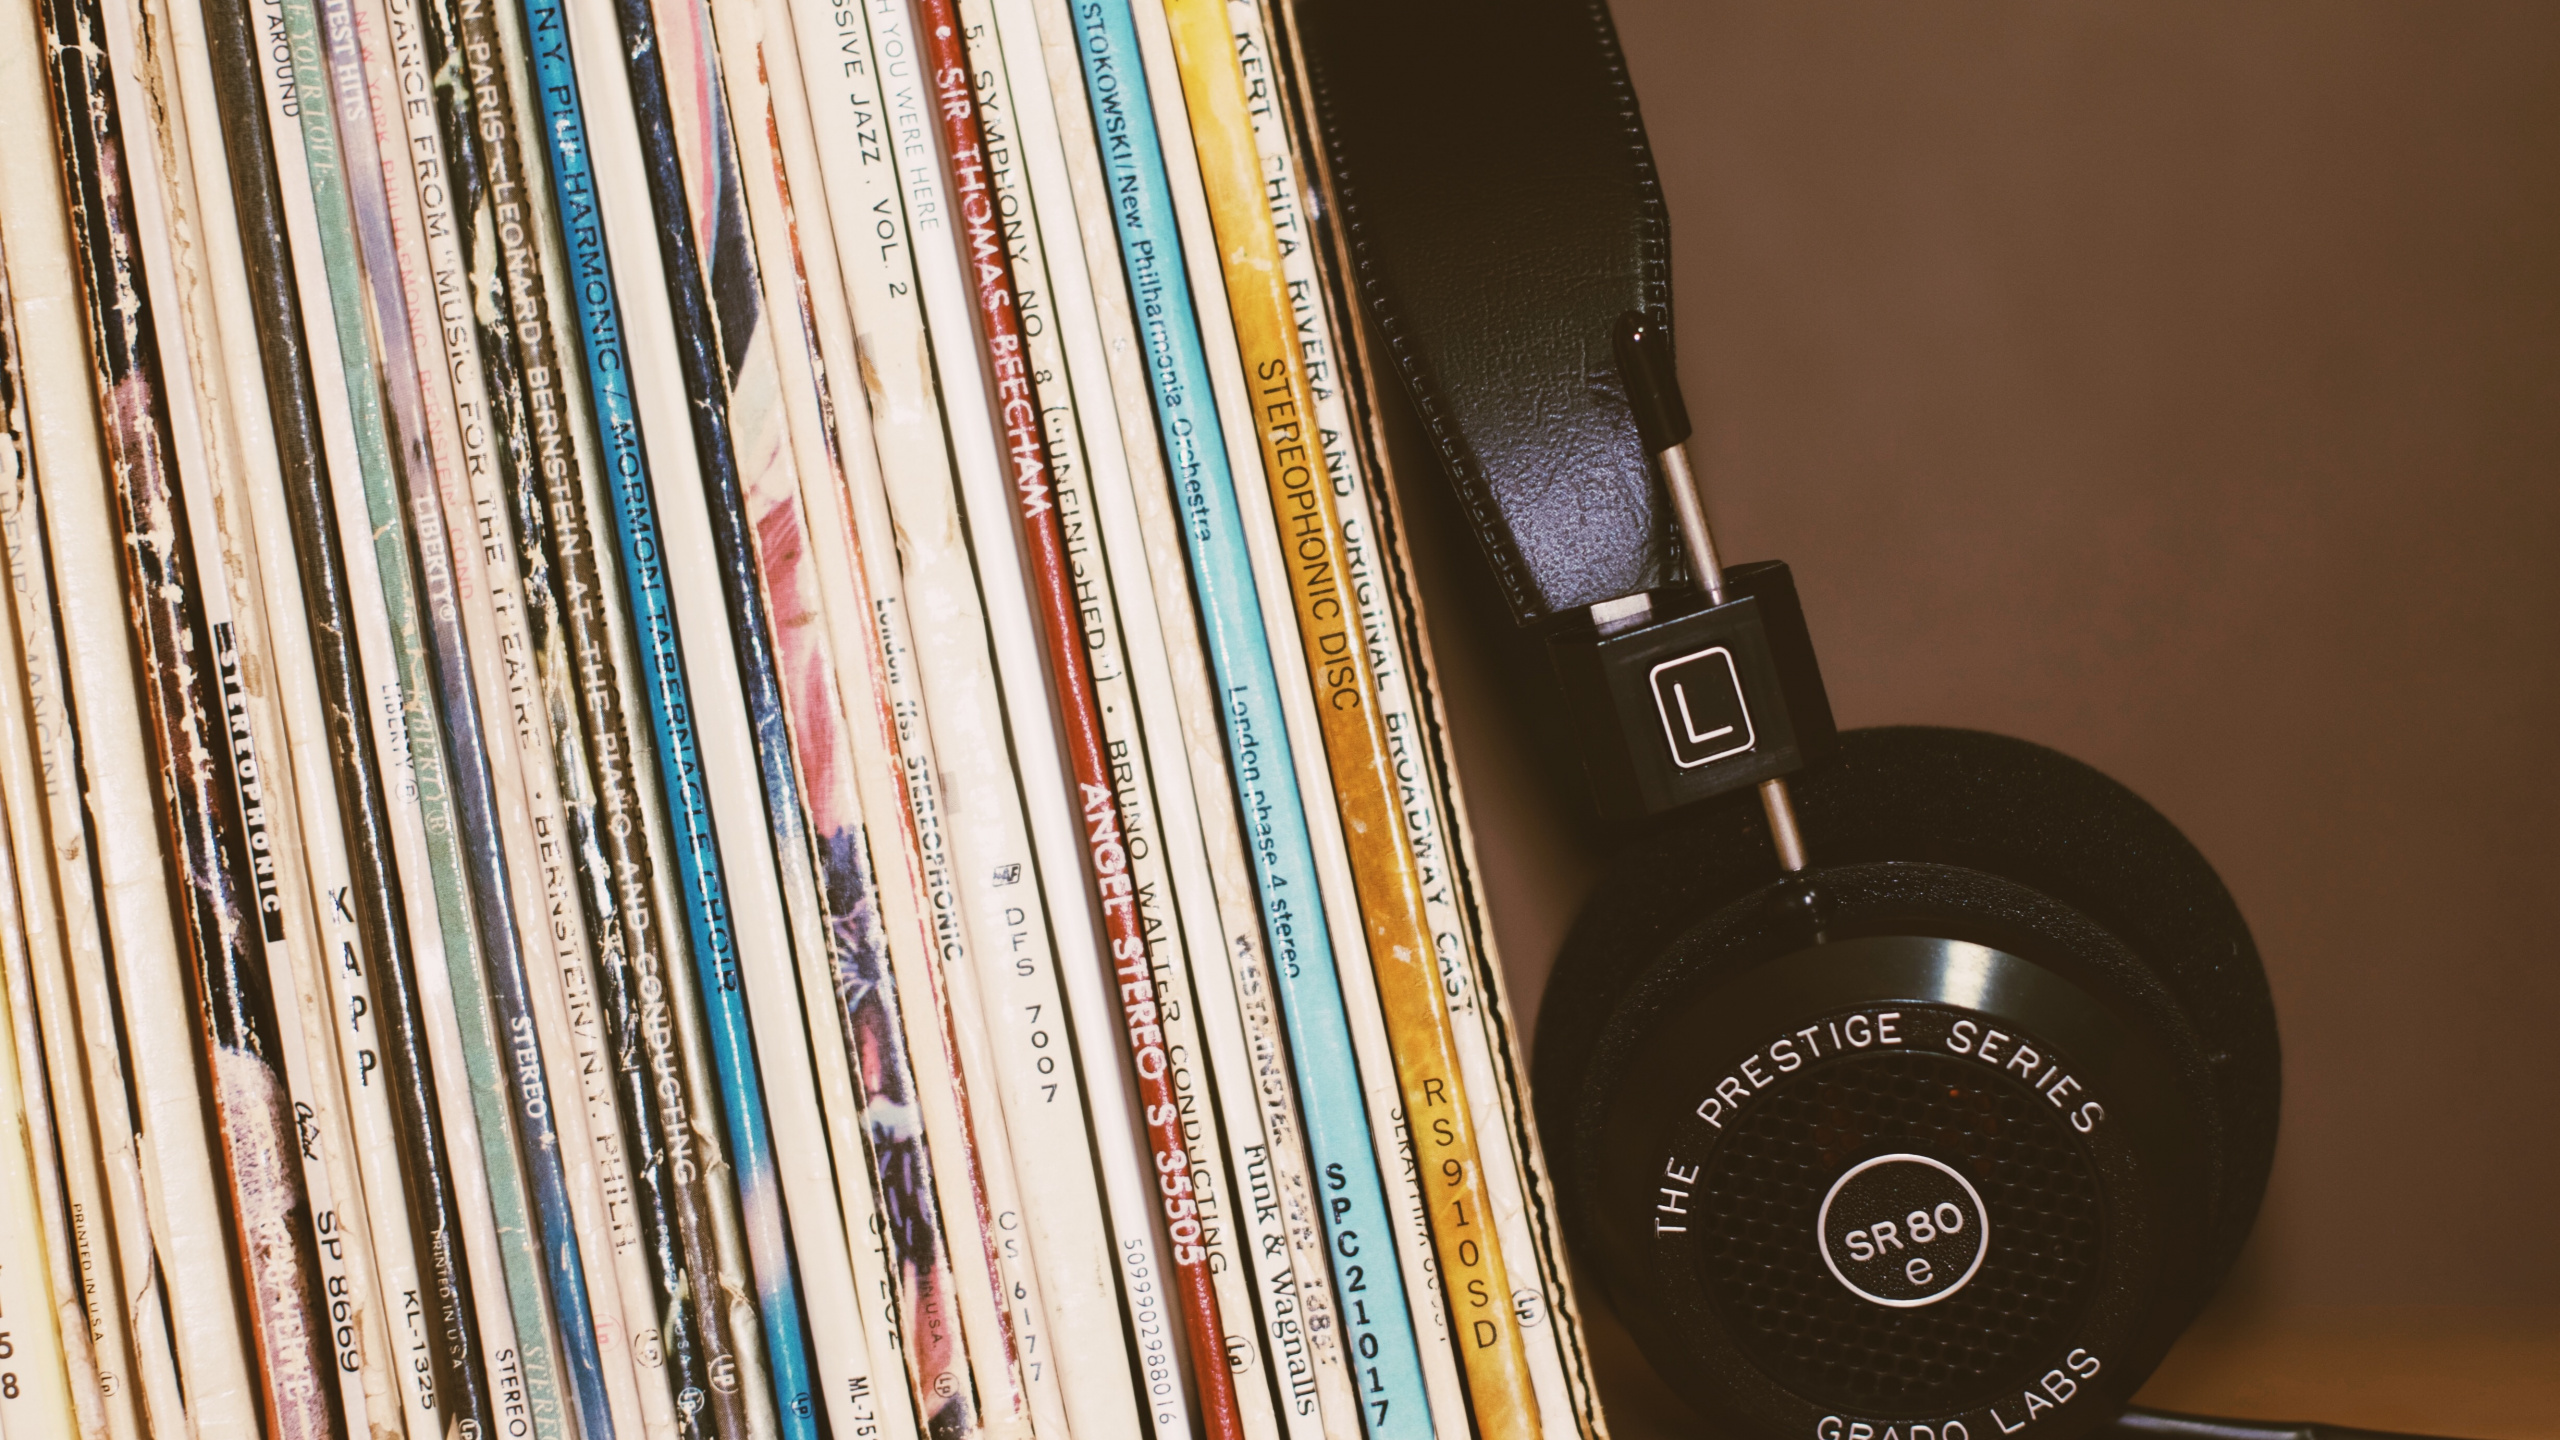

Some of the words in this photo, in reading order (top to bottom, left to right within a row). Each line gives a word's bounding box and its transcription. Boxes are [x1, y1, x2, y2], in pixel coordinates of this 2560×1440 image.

[266, 12, 300, 119] AROUND
[533, 5, 566, 69] N.Y.
[879, 22, 909, 78] YOU
[337, 62, 368, 122] HITS
[892, 87, 924, 157] WERE
[933, 64, 972, 122] SIR
[413, 135, 450, 238] FROM
[548, 83, 621, 374] PHILHARMONIC
[849, 91, 881, 166] JAZZ
[871, 198, 902, 269] VOL.
[888, 280, 908, 298] 2
[909, 166, 940, 231] HERE
[950, 142, 1010, 311] THOMAS
[353, 11, 376, 63] NEW
[365, 77, 391, 145] YORK
[380, 159, 427, 348] PHILHARMONIC
[418, 370, 456, 508] BERNSTEIN
[459, 400, 491, 476] FOR
[989, 333, 1052, 519] BEECHAM
[1131, 239, 1186, 408] Philharmonia
[1169, 416, 1215, 542] Orchestra
[525, 366, 581, 557] BERNSTEIN
[610, 422, 661, 591] MORMON
[474, 491, 507, 566] THE
[1256, 358, 1341, 622] STEREOPHONIC
[1317, 631, 1360, 712] DISC
[563, 576, 593, 622] AT
[1286, 278, 1333, 403] RIVERA
[1320, 425, 1355, 497] AND
[1340, 517, 1400, 692] ORIGINAL
[1384, 710, 1448, 909] BROADWAY
[1435, 930, 1474, 1017] CAST
[577, 641, 611, 713] THE
[971, 70, 1029, 267] SYMPHONY
[1032, 368, 1053, 385] 8
[1107, 738, 1150, 861] BRUNO
[1136, 882, 1182, 1023] WALTER
[1166, 1044, 1228, 1276] CONDUCTING
[1674, 682, 1733, 743] L
[644, 605, 710, 855] TABERNACLE
[875, 597, 910, 684] London
[905, 754, 963, 961] STEREOPHONIC
[1226, 685, 1265, 781] London
[217, 648, 279, 914] STEREOPHONIC
[593, 732, 632, 839] PIANO
[1243, 790, 1284, 867] phase
[616, 860, 649, 931] AND
[1078, 778, 1135, 915] ANGEL
[1265, 872, 1287, 892] 4
[695, 869, 738, 995] CHOIR
[1270, 899, 1301, 979] stereo
[1024, 1004, 1060, 1103] 7007
[1111, 934, 1169, 1081] STEREO
[509, 1015, 548, 1119] STEREO
[633, 951, 697, 1186] CONDUCTING
[1145, 1100, 1178, 1128] S
[1654, 1156, 1701, 1238] THE
[1696, 1012, 1902, 1129] PRESTIGE
[1946, 1020, 2106, 1133] SERIES
[1154, 1146, 1207, 1267] 35505
[1242, 1142, 1282, 1224] Funk
[1845, 1221, 1904, 1261] SR
[1906, 1202, 1963, 1243] 80
[72, 1203, 92, 1270] PRINTED
[84, 1277, 96, 1294] IN
[314, 1210, 342, 1262] SP
[428, 1229, 451, 1298] PRINTED
[442, 1304, 455, 1321] IN
[1261, 1230, 1286, 1259] &
[1905, 1258, 1933, 1285] e
[325, 1274, 360, 1373] 8669
[403, 1289, 436, 1410] KL-1325
[1123, 1237, 1178, 1425] 5099902988016
[1262, 1267, 1319, 1417] Wagnalls
[494, 1347, 528, 1438] STEREO
[1990, 1348, 2100, 1434] LABS
